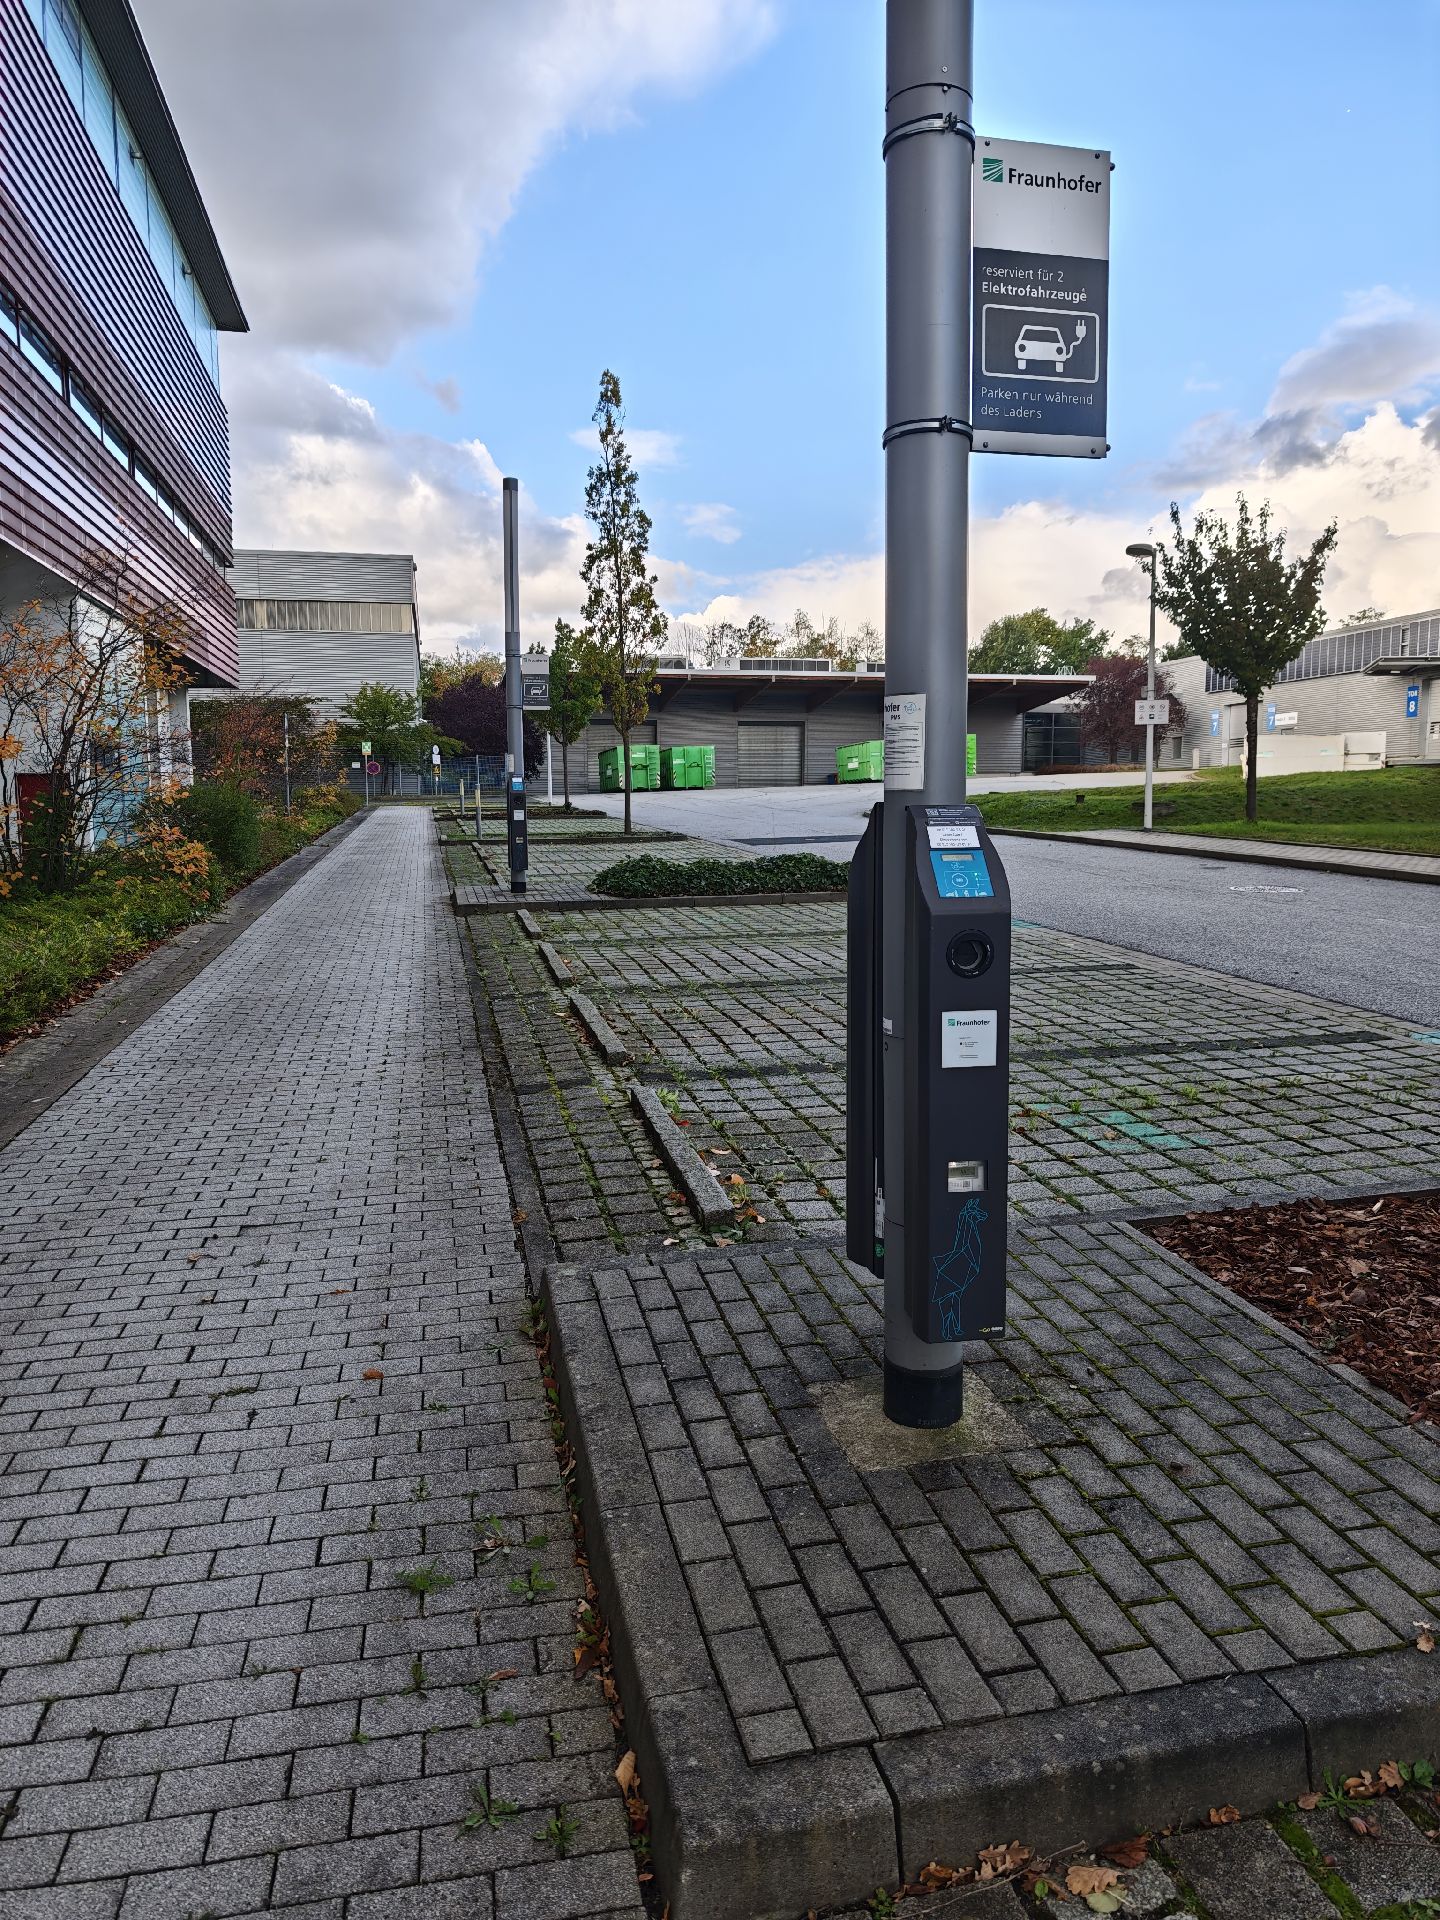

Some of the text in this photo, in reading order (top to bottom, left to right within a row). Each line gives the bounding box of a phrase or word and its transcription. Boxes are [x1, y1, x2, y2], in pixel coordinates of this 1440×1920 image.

[1008, 167, 1102, 194] Fraunhofer
[982, 266, 1064, 283] reserviert für 2
[982, 281, 1087, 303] Elektrofahrzeuge
[981, 386, 1093, 405] Parken nur während
[980, 404, 1000, 416] des
[1409, 700, 1416, 713] 8
[1212, 721, 1218, 732] 7
[1268, 716, 1274, 726] 7
